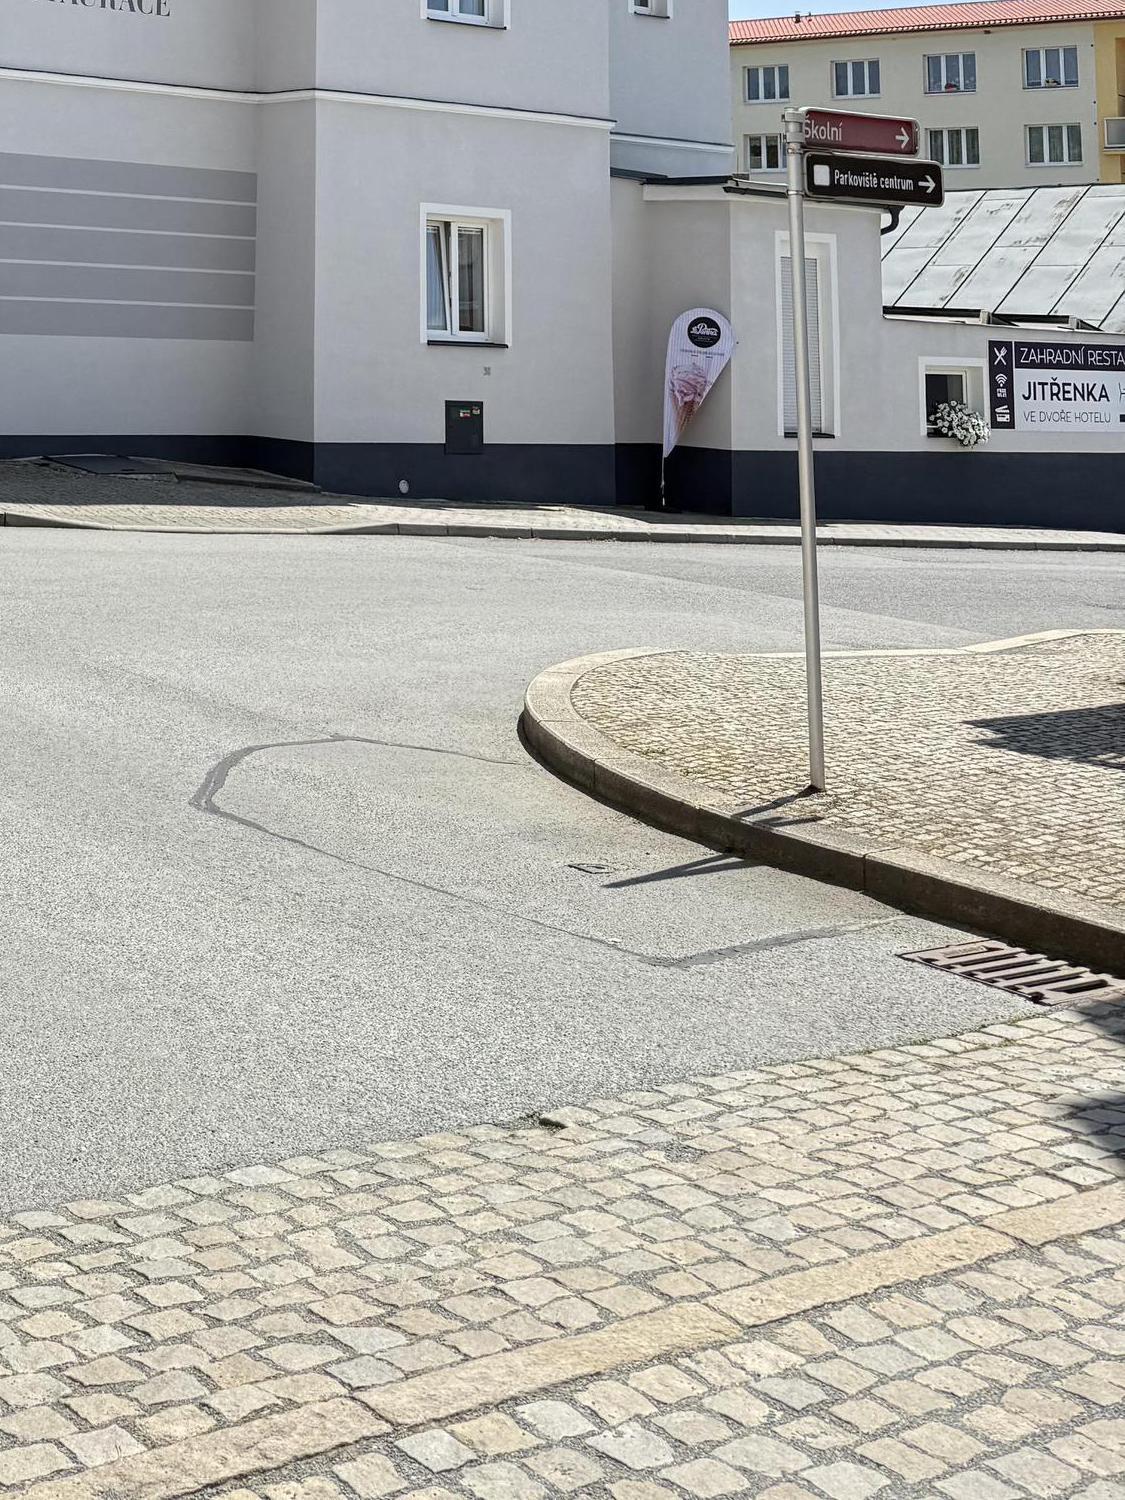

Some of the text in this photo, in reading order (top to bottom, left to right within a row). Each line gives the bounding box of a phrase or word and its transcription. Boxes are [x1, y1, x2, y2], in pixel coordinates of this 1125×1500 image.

[834, 169, 914, 191] Parkoviště centrum
[1020, 346, 1085, 365] ZAHRADNÍ
[1022, 377, 1111, 402] JITŘENKA
[1023, 409, 1111, 424] VE DVOŘE HOTELU
